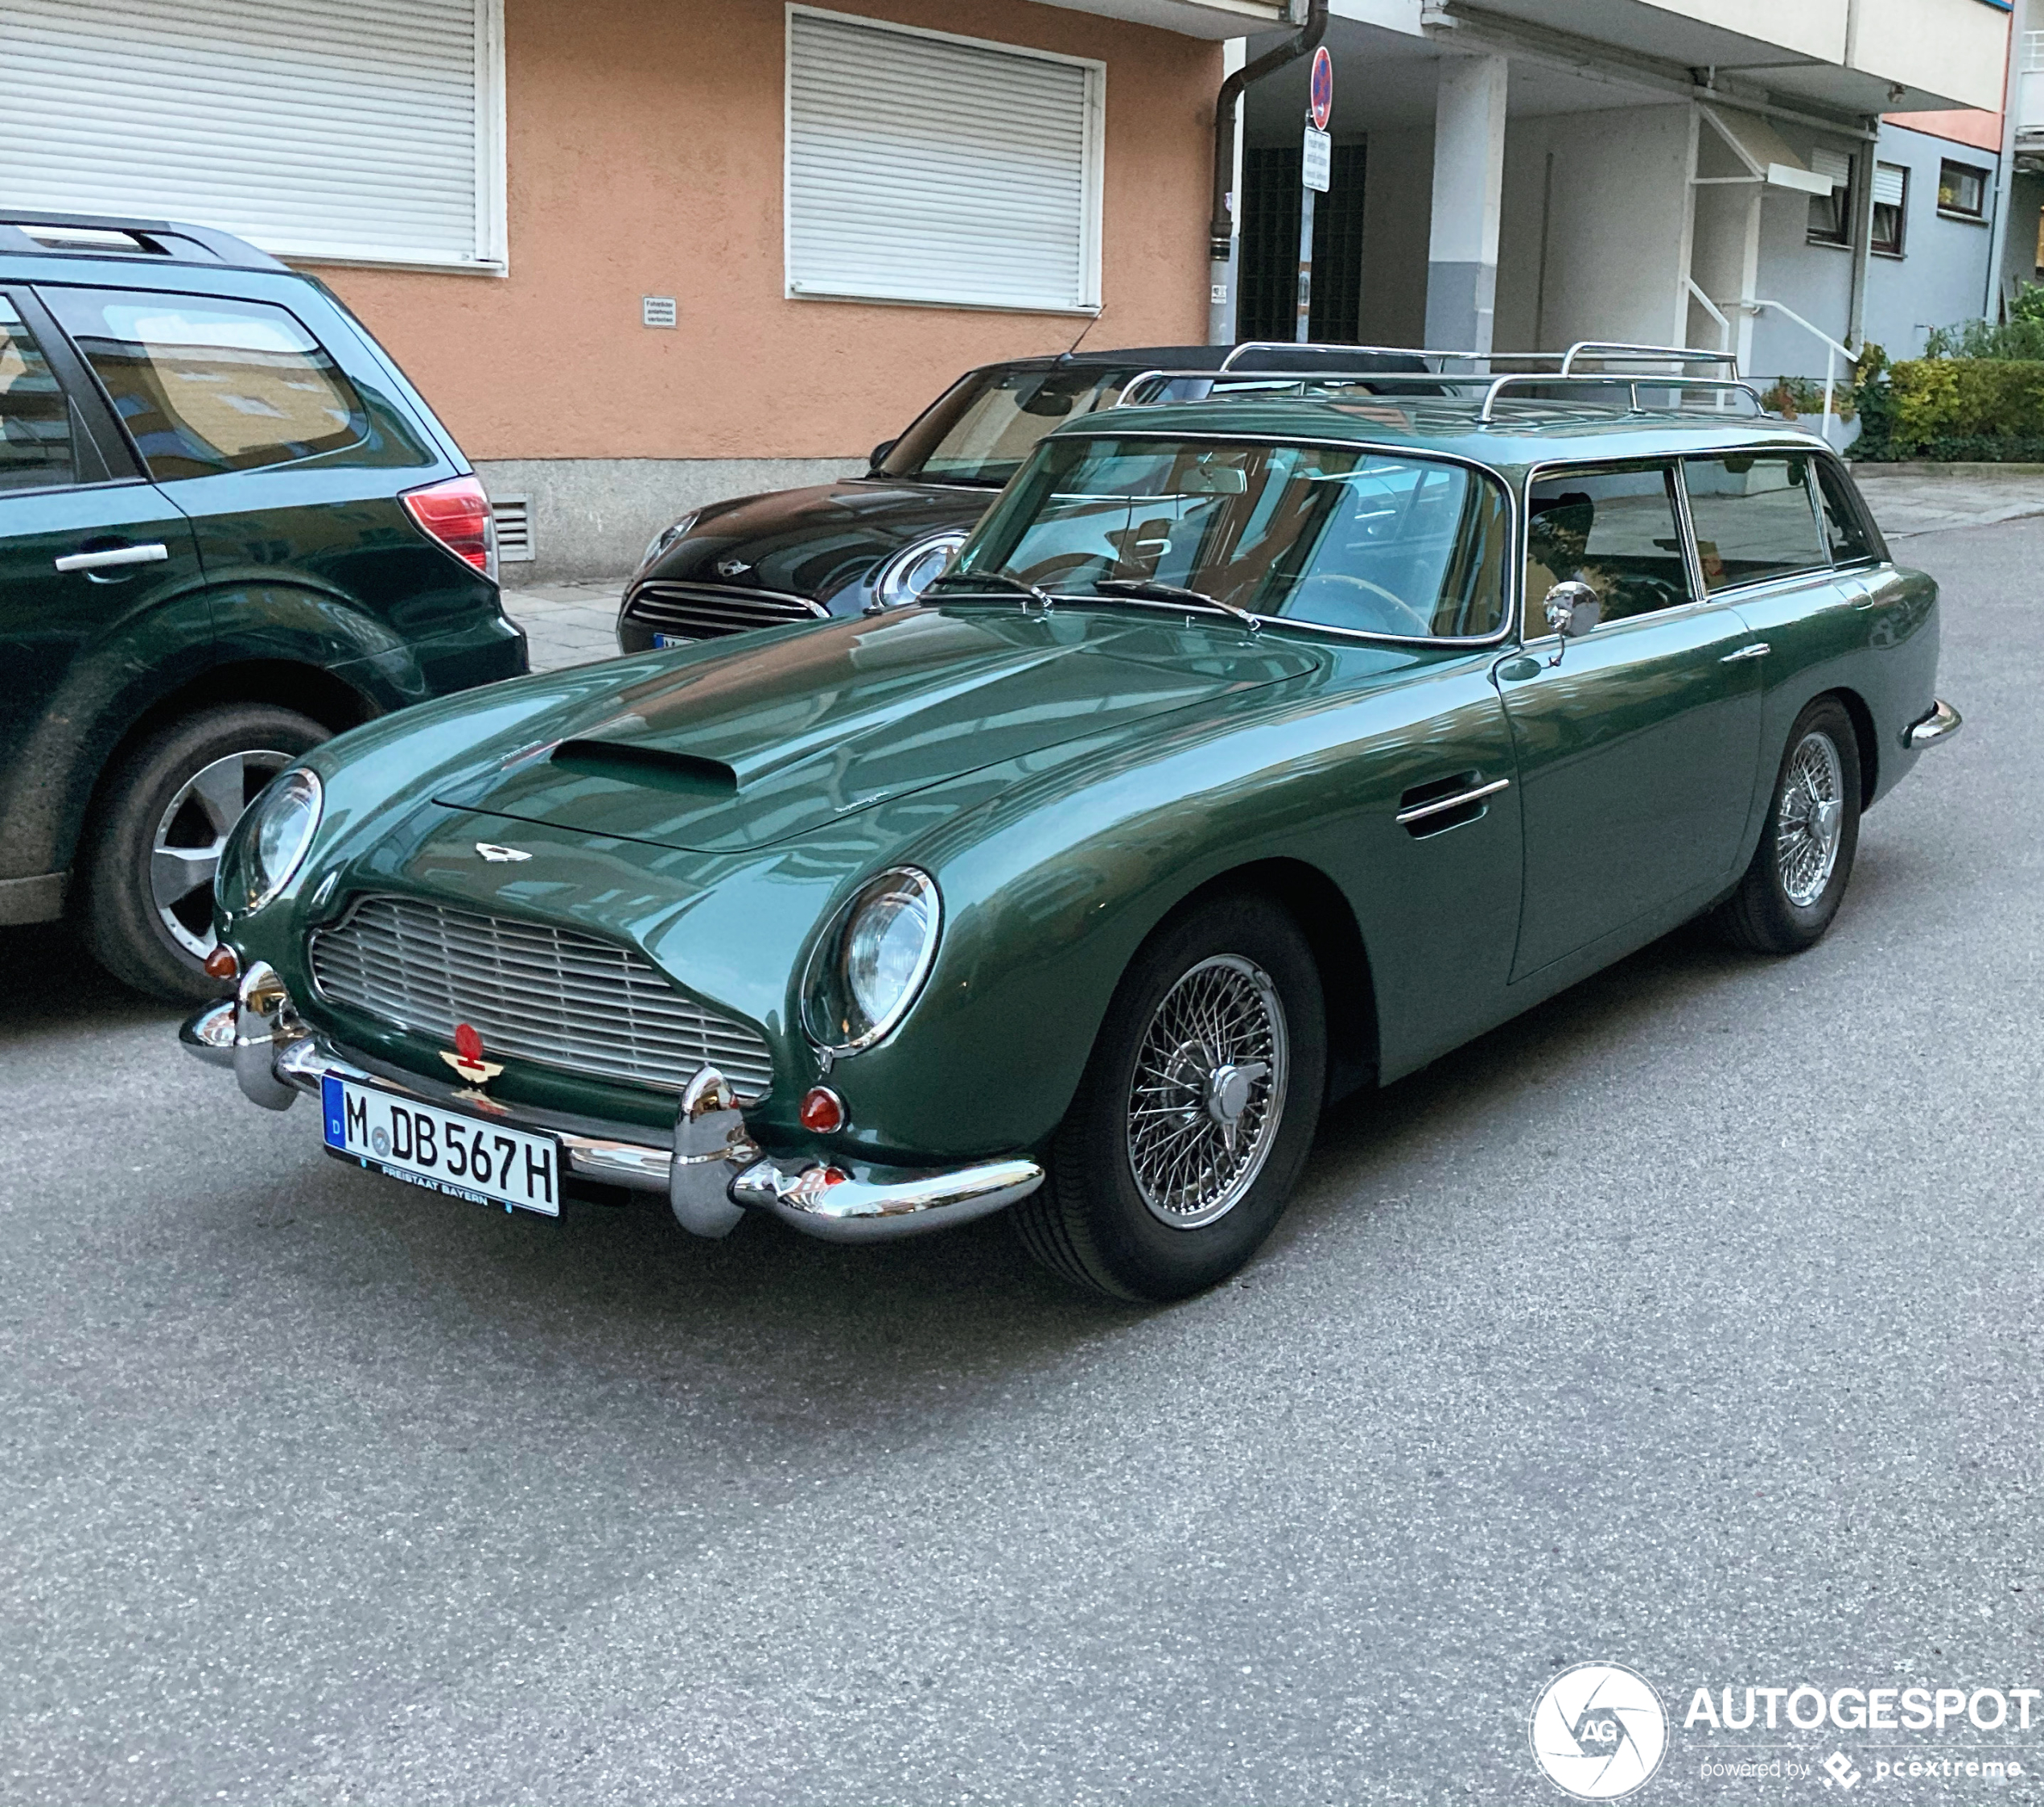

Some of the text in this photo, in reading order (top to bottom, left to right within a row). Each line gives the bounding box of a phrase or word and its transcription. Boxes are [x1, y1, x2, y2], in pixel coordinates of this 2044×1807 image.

[332, 1120, 340, 1135] D
[345, 1091, 369, 1148] M
[381, 1165, 488, 1206] FREISTAAT BAYERN
